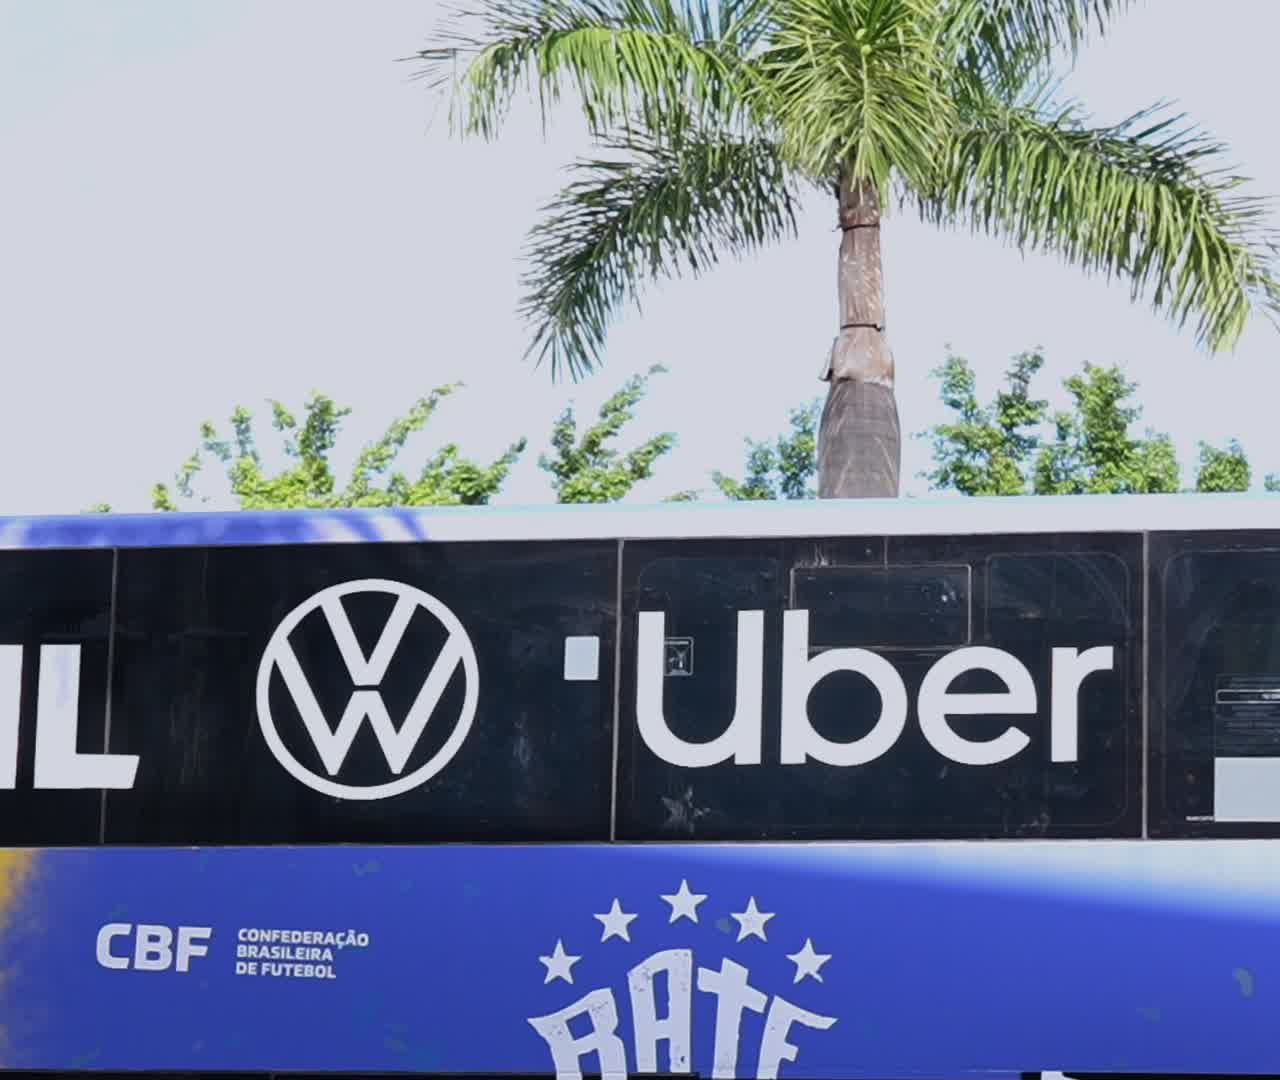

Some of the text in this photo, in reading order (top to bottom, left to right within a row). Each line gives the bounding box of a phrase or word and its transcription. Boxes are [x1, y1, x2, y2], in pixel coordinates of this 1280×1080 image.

[636, 608, 1115, 768] Uber
[95, 922, 213, 973] CBF
[237, 927, 370, 949] CONFEDERAÇÃO
[236, 944, 334, 962] BRASILEIRA
[235, 960, 337, 979] DE FUTEBOL
